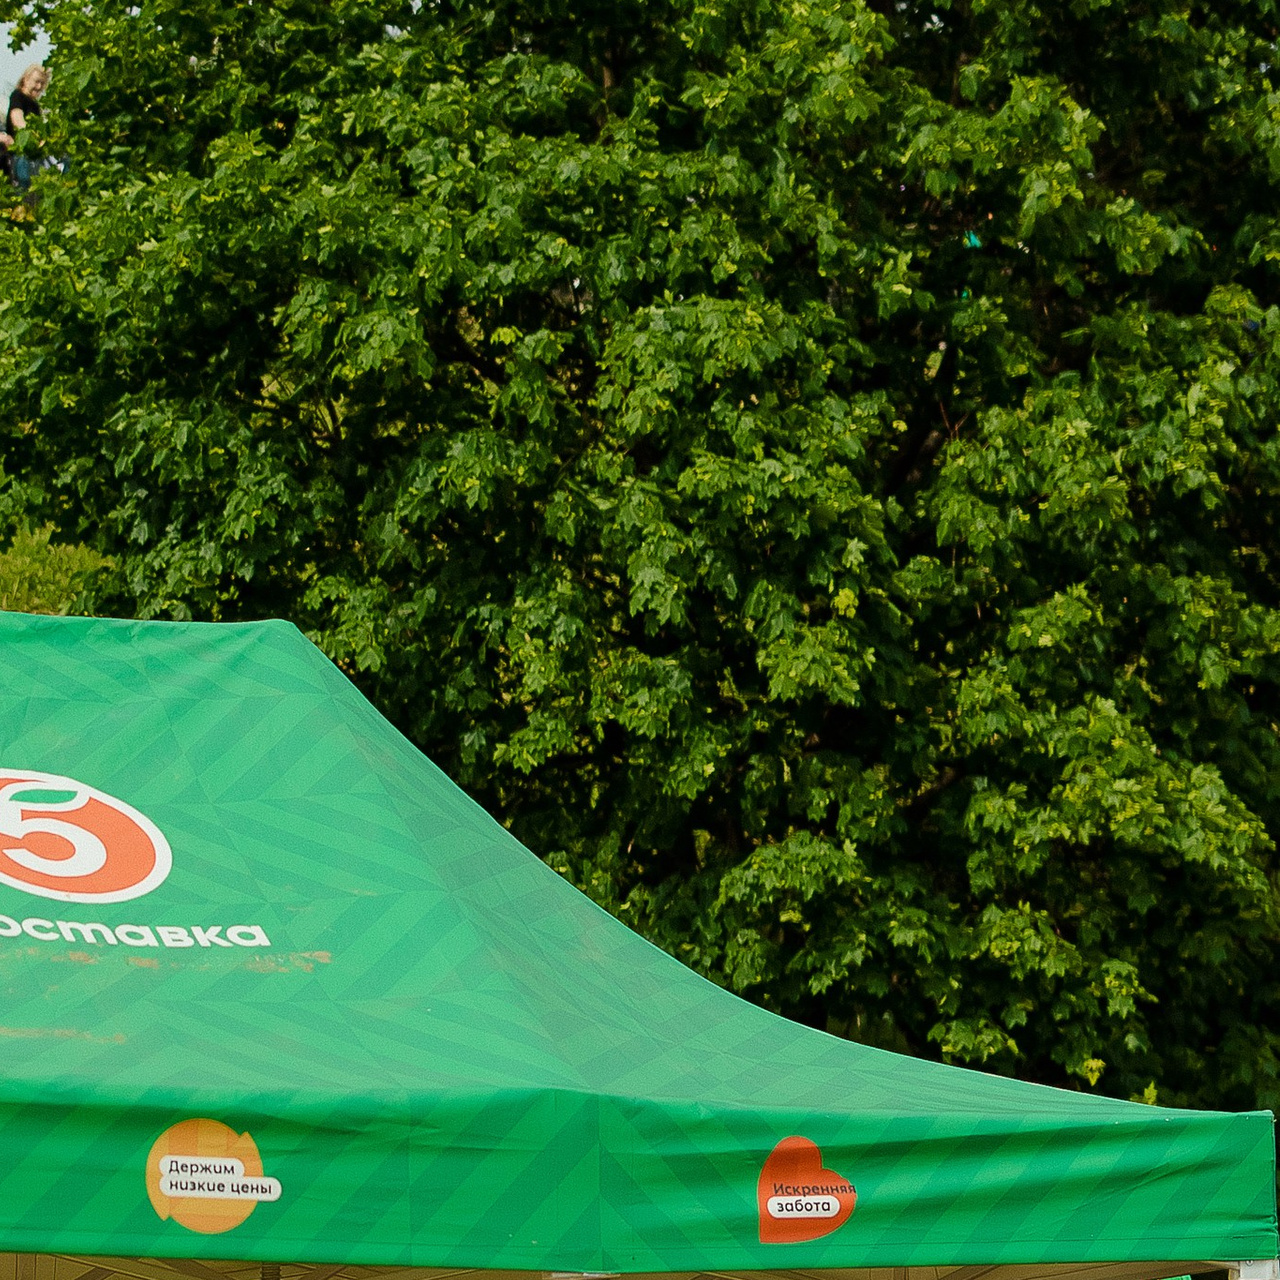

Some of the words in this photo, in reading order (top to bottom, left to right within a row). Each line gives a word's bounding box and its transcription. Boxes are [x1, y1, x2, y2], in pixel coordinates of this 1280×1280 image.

[168, 1160, 235, 1176] Держим
[169, 1180, 226, 1192] низкие
[231, 1182, 272, 1195] цены
[773, 1183, 857, 1197] Искренняя
[776, 1199, 831, 1212] забота
